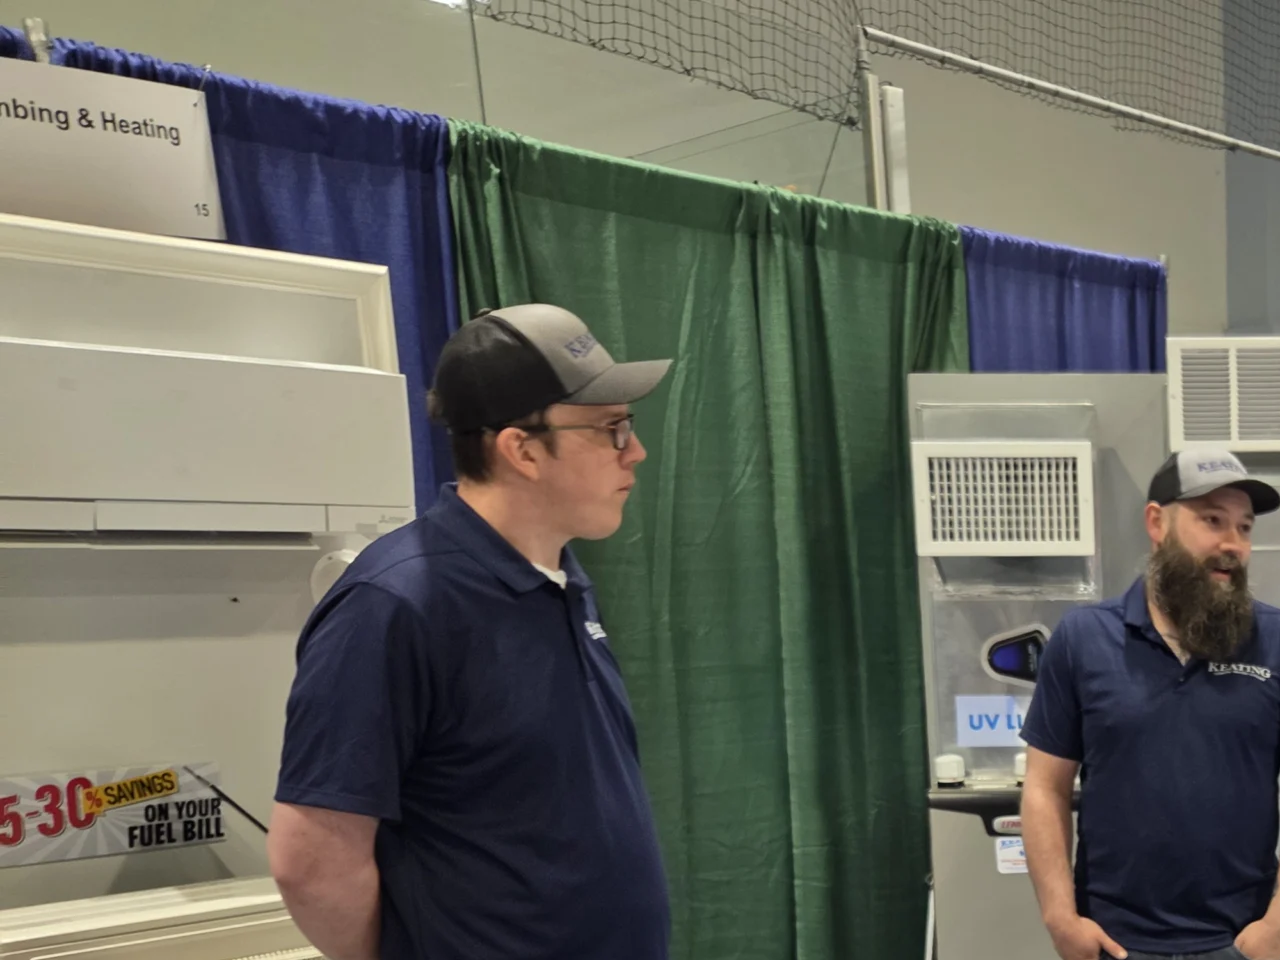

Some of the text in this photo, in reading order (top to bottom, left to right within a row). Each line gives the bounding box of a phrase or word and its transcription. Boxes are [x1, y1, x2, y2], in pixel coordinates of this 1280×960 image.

[77, 107, 96, 129] &
[100, 111, 181, 146] Heating
[194, 203, 210, 217] 15
[1208, 661, 1271, 680] KEATING
[968, 714, 1000, 730] UV
[102, 771, 177, 806] SAVINGS
[144, 798, 222, 823] ON YOUR
[128, 817, 225, 849] FUEL BILL
